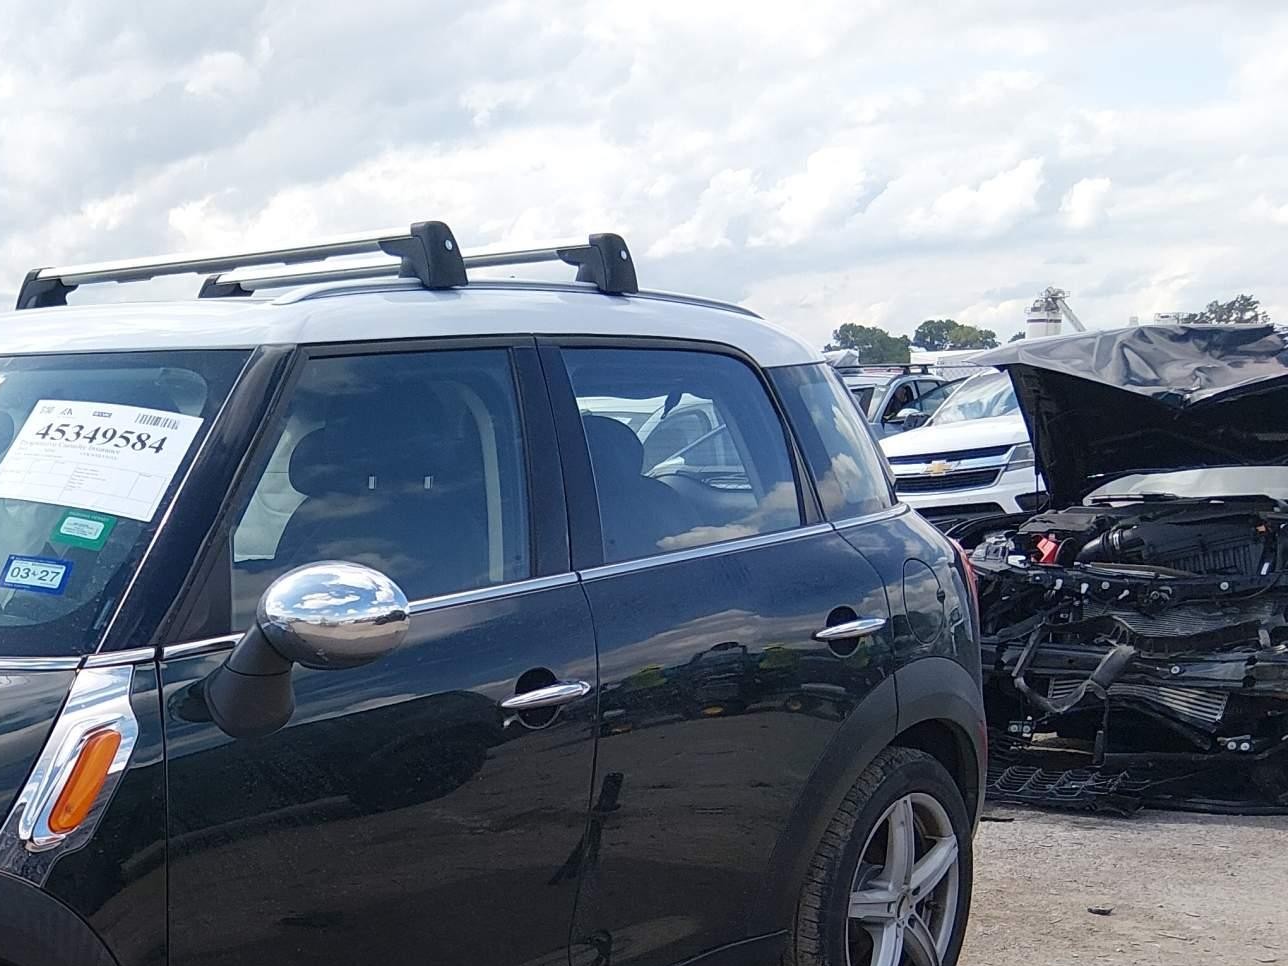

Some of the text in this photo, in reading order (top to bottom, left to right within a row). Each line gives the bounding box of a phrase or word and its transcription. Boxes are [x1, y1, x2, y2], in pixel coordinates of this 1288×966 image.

[35, 423, 168, 454] 45349584
[10, 566, 61, 583] 03 27
